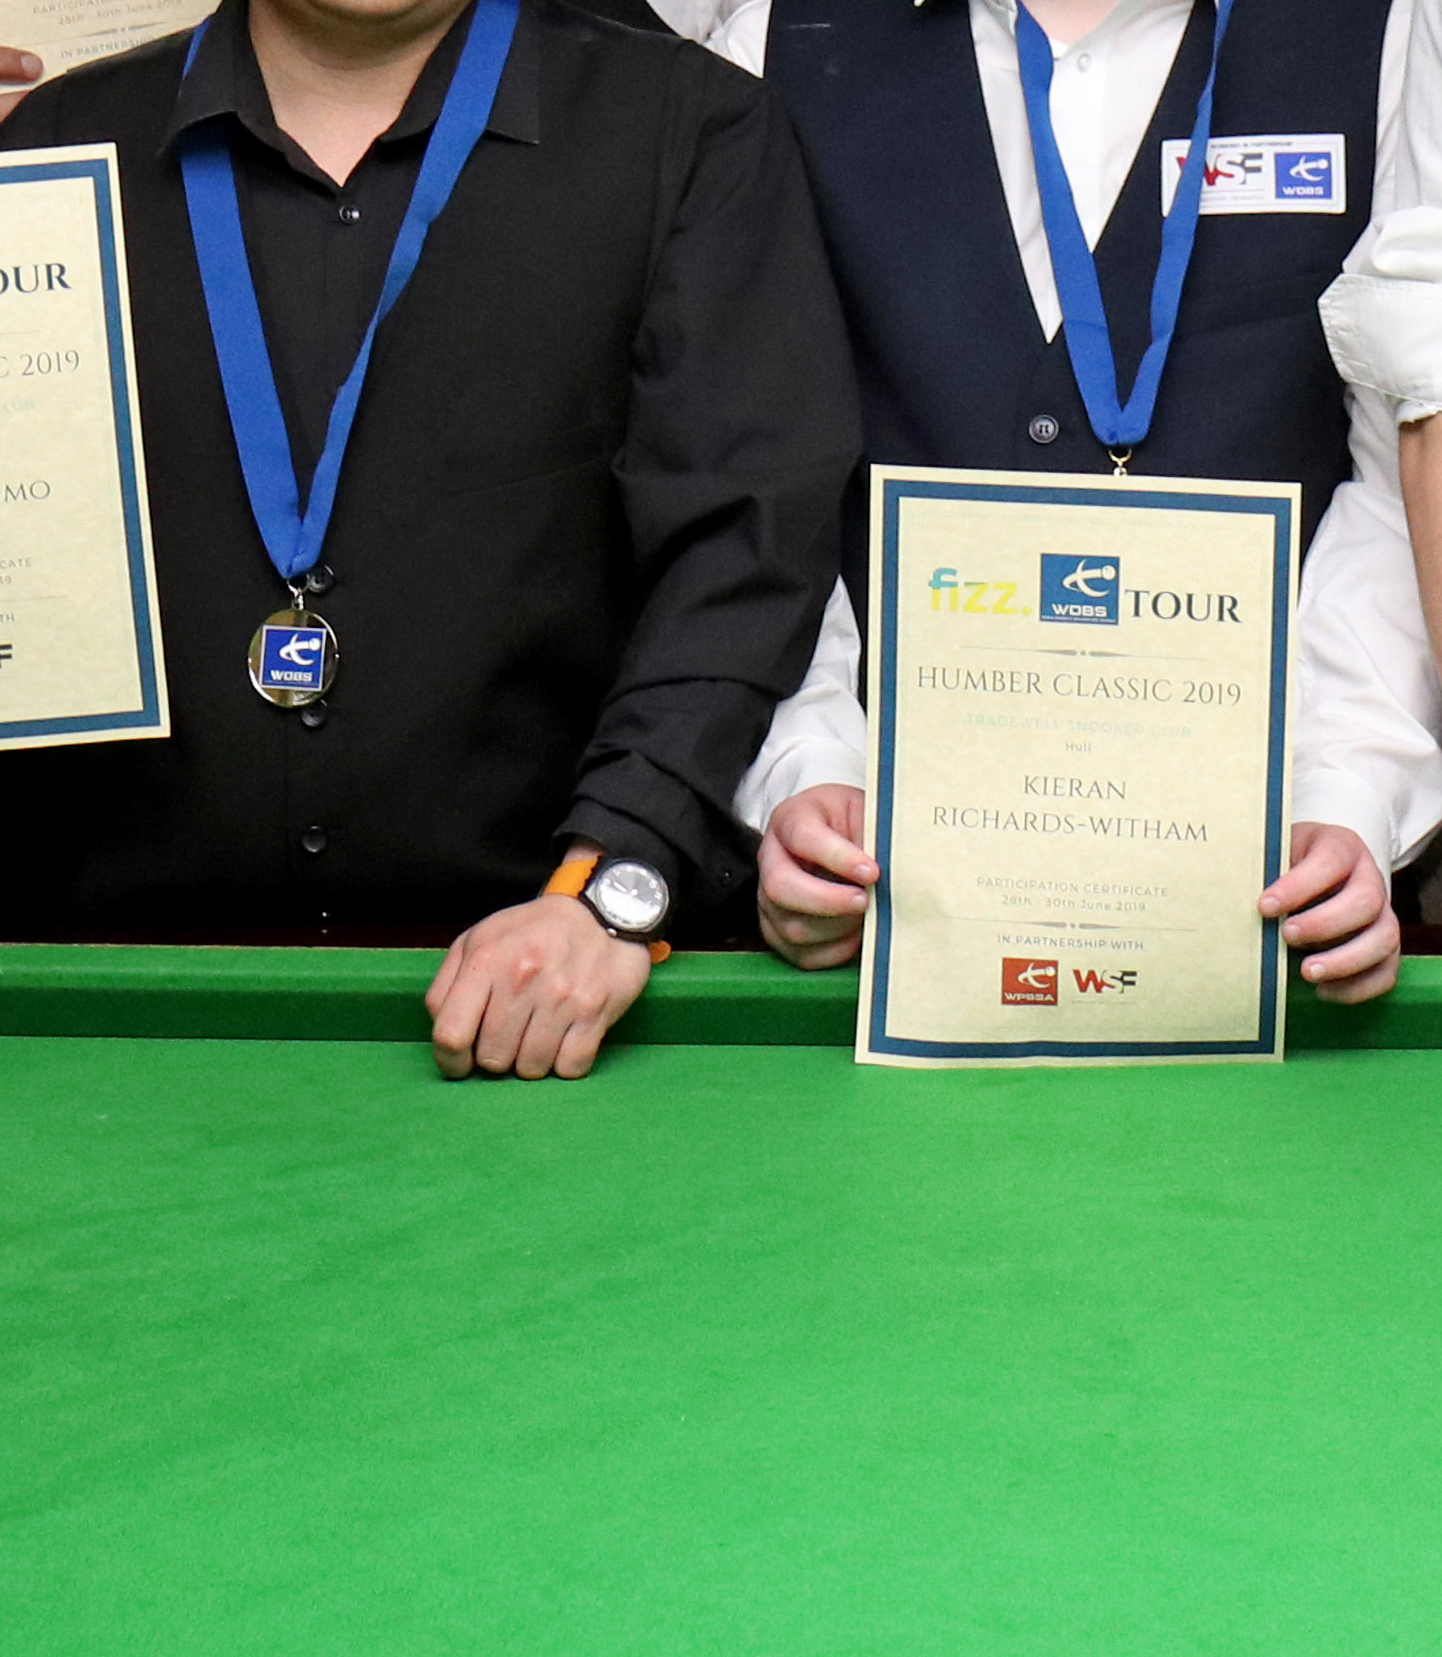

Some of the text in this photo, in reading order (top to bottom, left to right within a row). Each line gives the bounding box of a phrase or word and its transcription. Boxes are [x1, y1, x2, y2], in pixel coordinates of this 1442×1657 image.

[60, 48, 72, 59] IN
[1282, 186, 1324, 196] WDBS
[19, 349, 80, 377] 2019
[928, 567, 1242, 623] fizz. WDBS TOUR
[918, 666, 1242, 707] HUMBER CLASSIC 2019
[1065, 742, 1091, 753] Hull
[1024, 775, 1126, 800] KIERAN
[932, 806, 1208, 842] RICHARDS-WITHAM
[976, 876, 1168, 897] PARTICIPATION CERTIFICATE
[1002, 895, 1146, 912] 28th 30th June 2019
[997, 934, 1144, 950] IN PARTNERSHIP WITH
[1072, 968, 1137, 994] WSF
